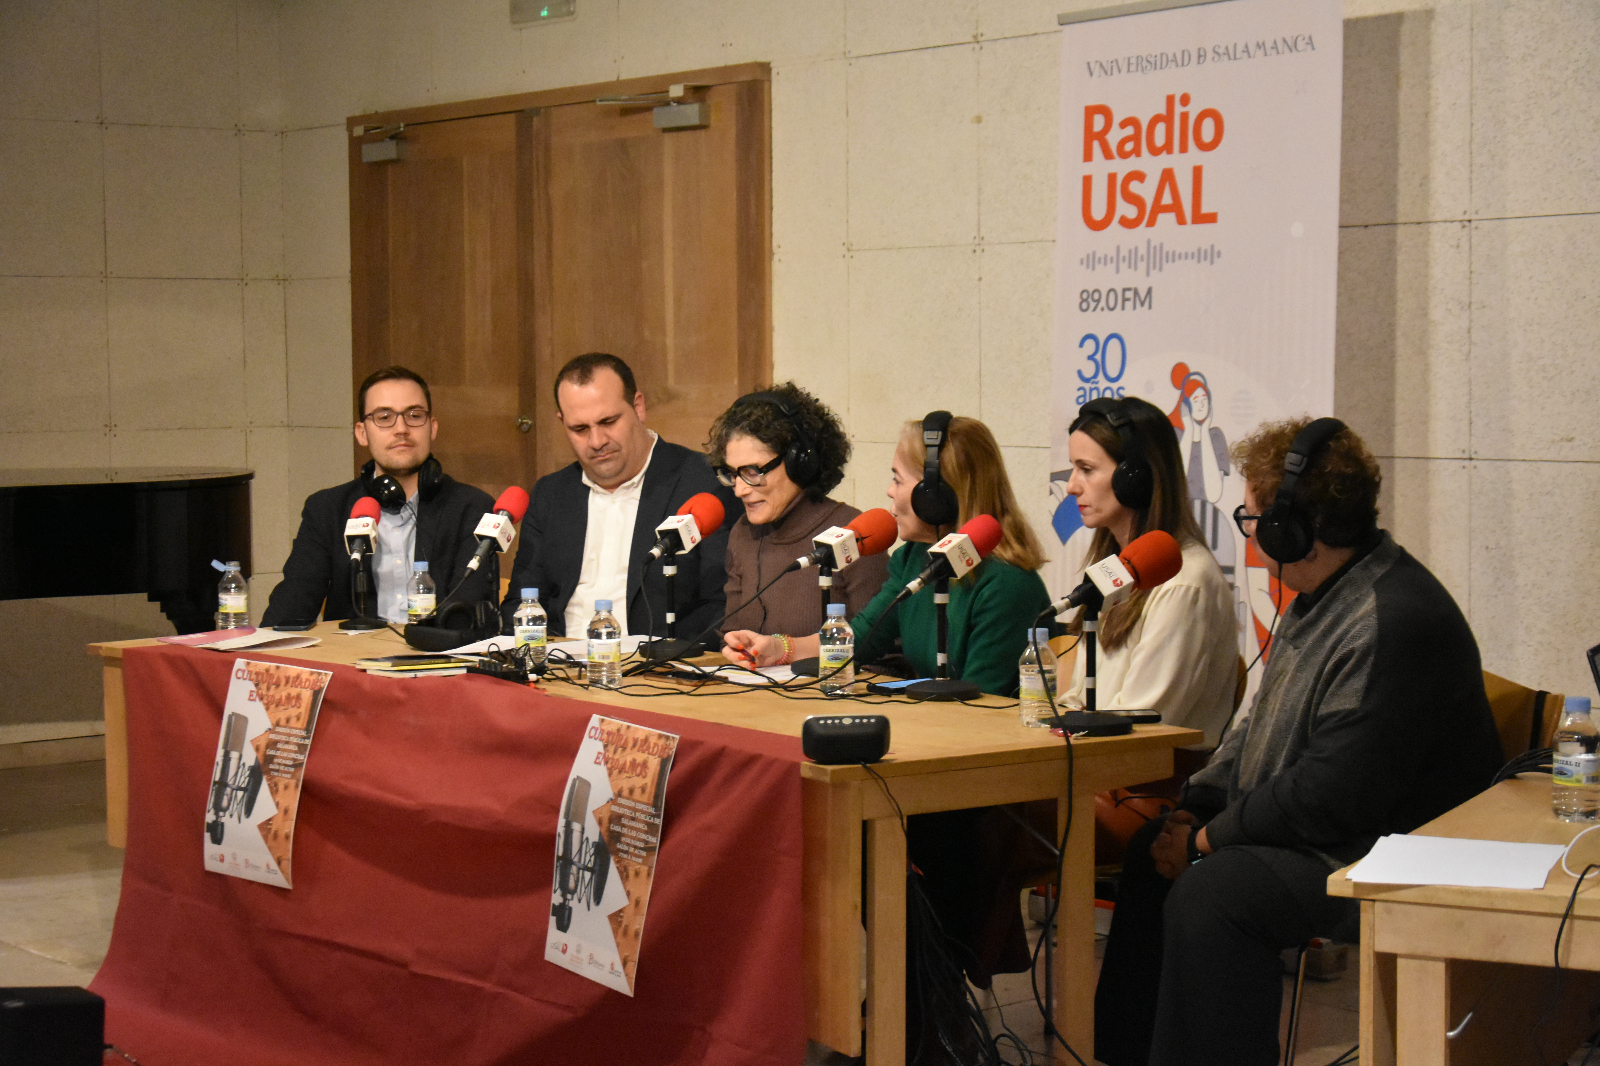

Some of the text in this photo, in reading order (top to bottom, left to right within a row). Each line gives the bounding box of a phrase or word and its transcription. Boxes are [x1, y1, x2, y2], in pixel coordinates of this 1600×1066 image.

[1211, 34, 1316, 63] SALAMANCA
[1083, 92, 1225, 163] Radio
[1081, 164, 1218, 232] USAL
[1077, 333, 1127, 383] 30
[1075, 380, 1125, 405] años
[1101, 562, 1114, 579] USAL
[235, 668, 322, 690] CULTURA Y RADIO
[248, 690, 264, 702] EN
[588, 726, 672, 759] CULTURA Y RADIO
[594, 751, 609, 767] EN
